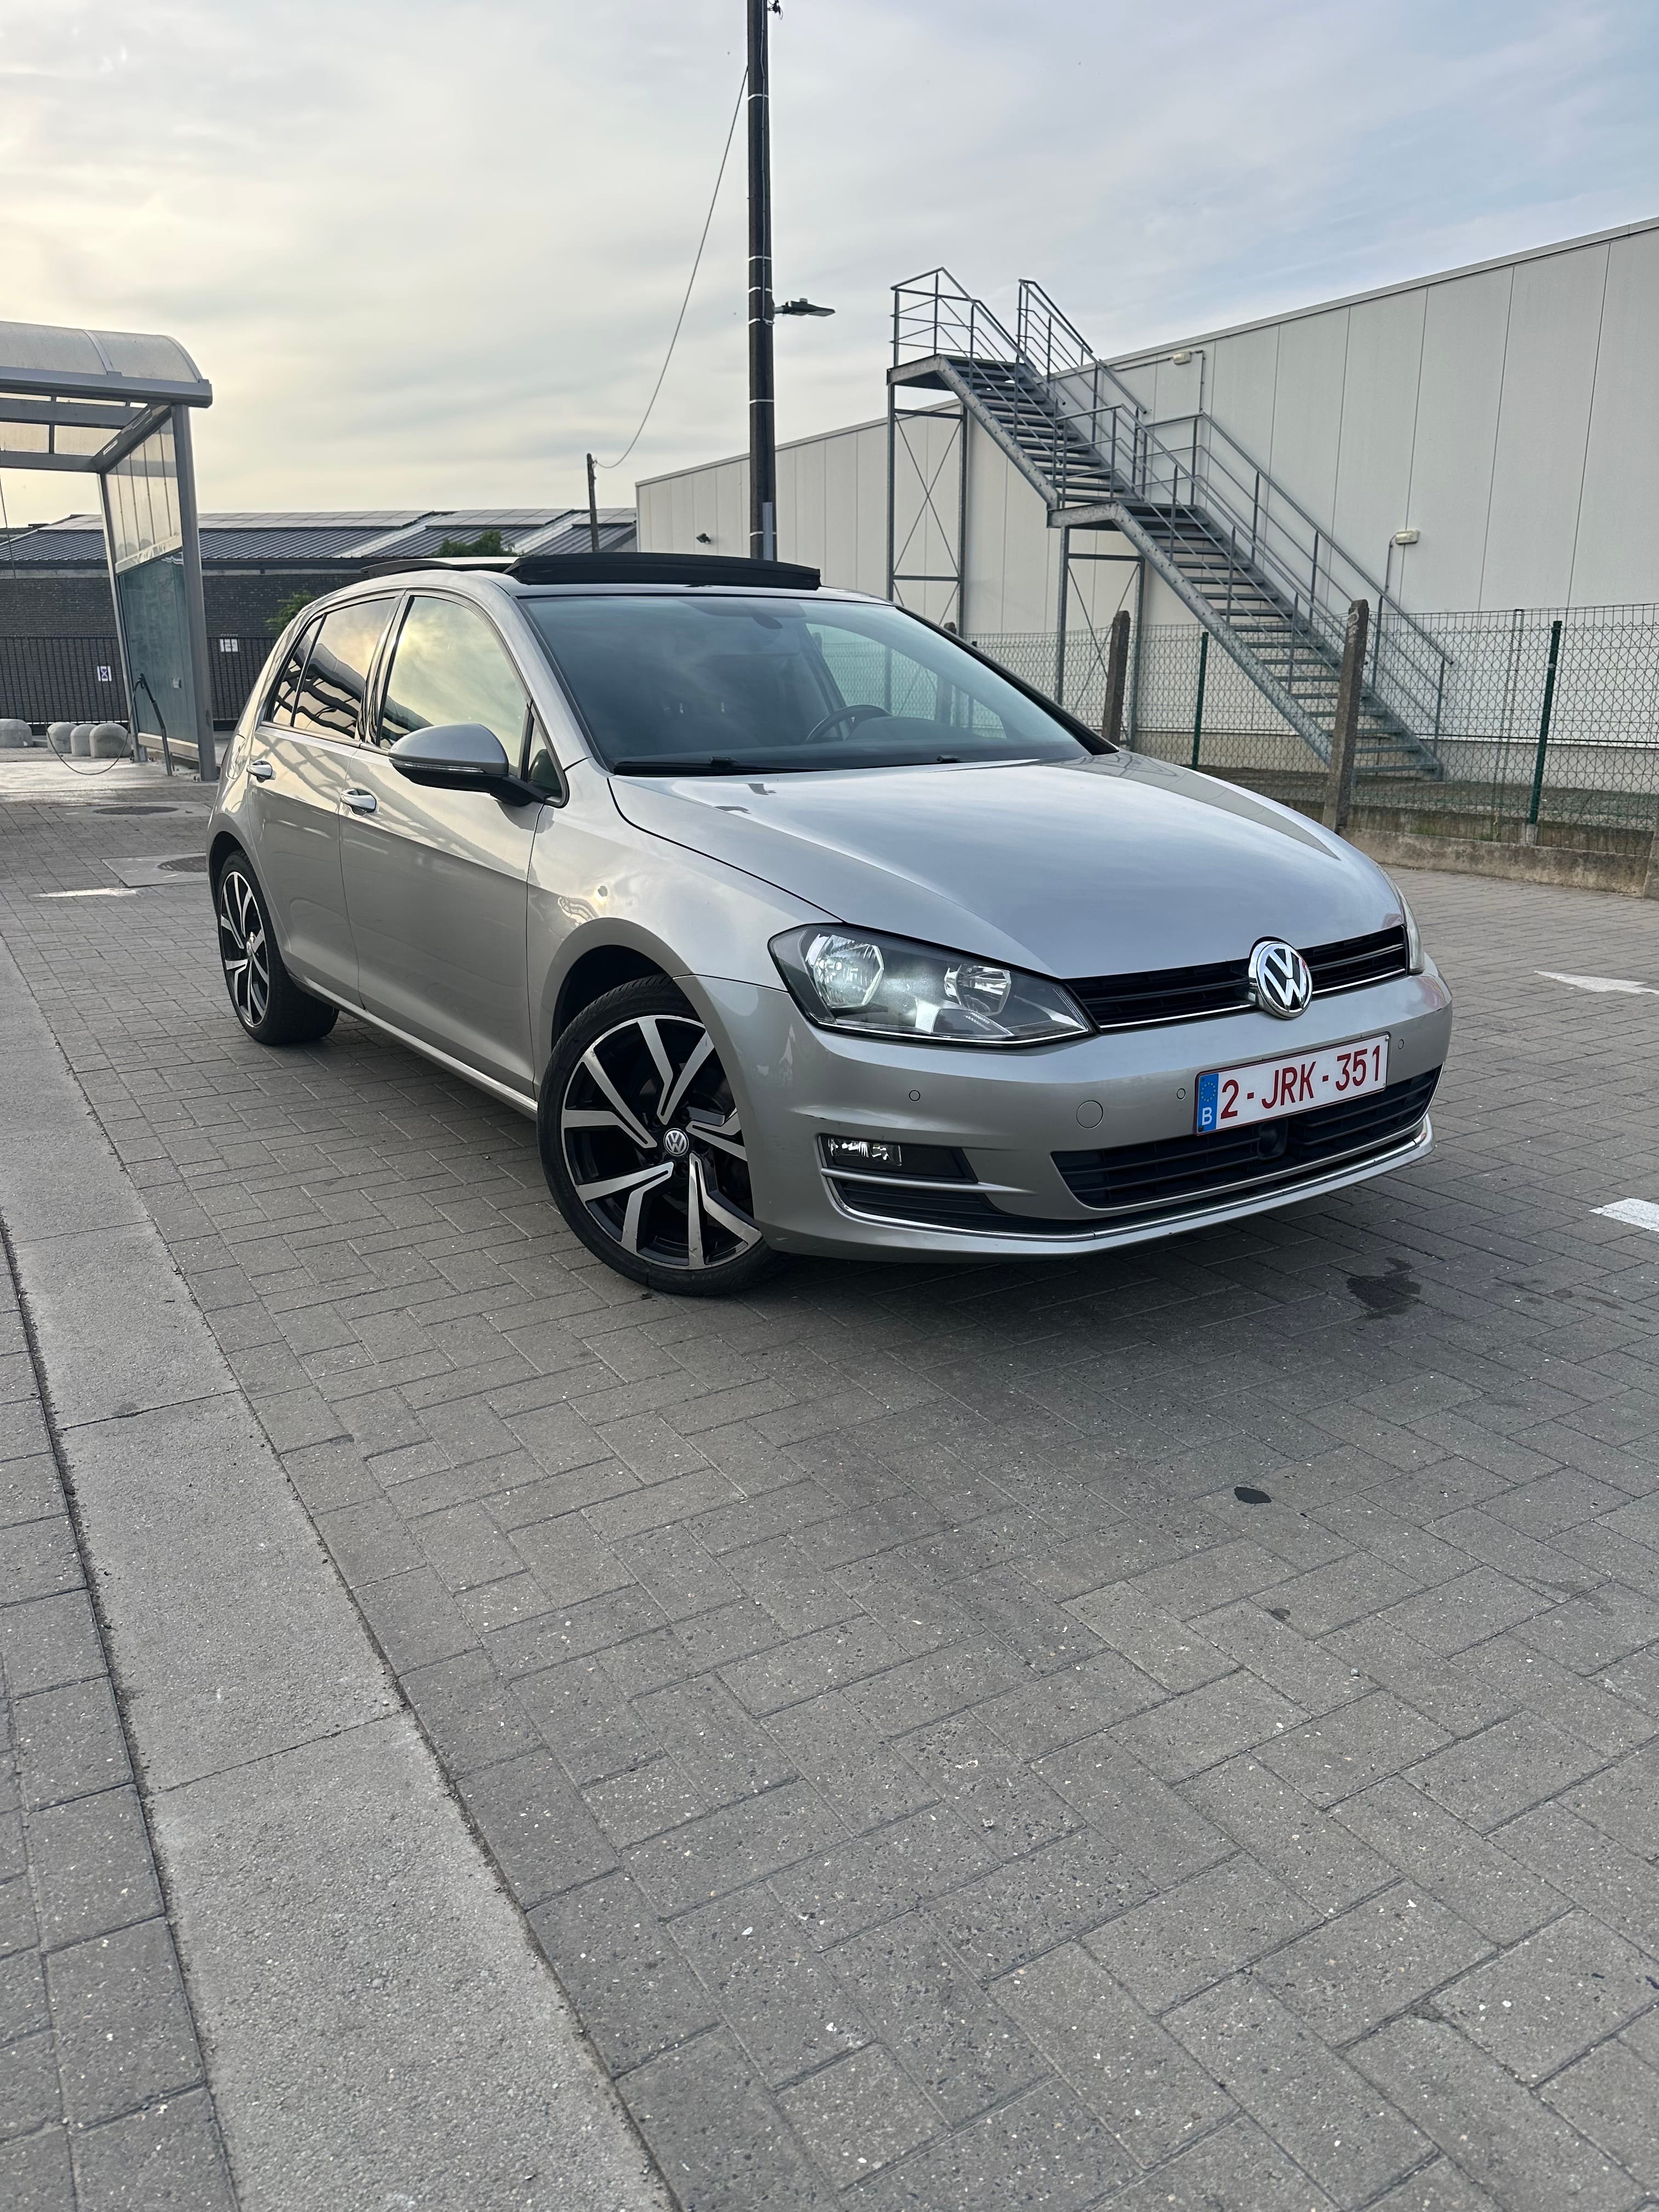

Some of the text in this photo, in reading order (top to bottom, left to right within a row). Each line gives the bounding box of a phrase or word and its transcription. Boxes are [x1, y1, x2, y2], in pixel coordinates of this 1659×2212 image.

[1258, 944, 1312, 1014] VW
[1201, 1107, 1212, 1126] B
[665, 1130, 687, 1155] VW
